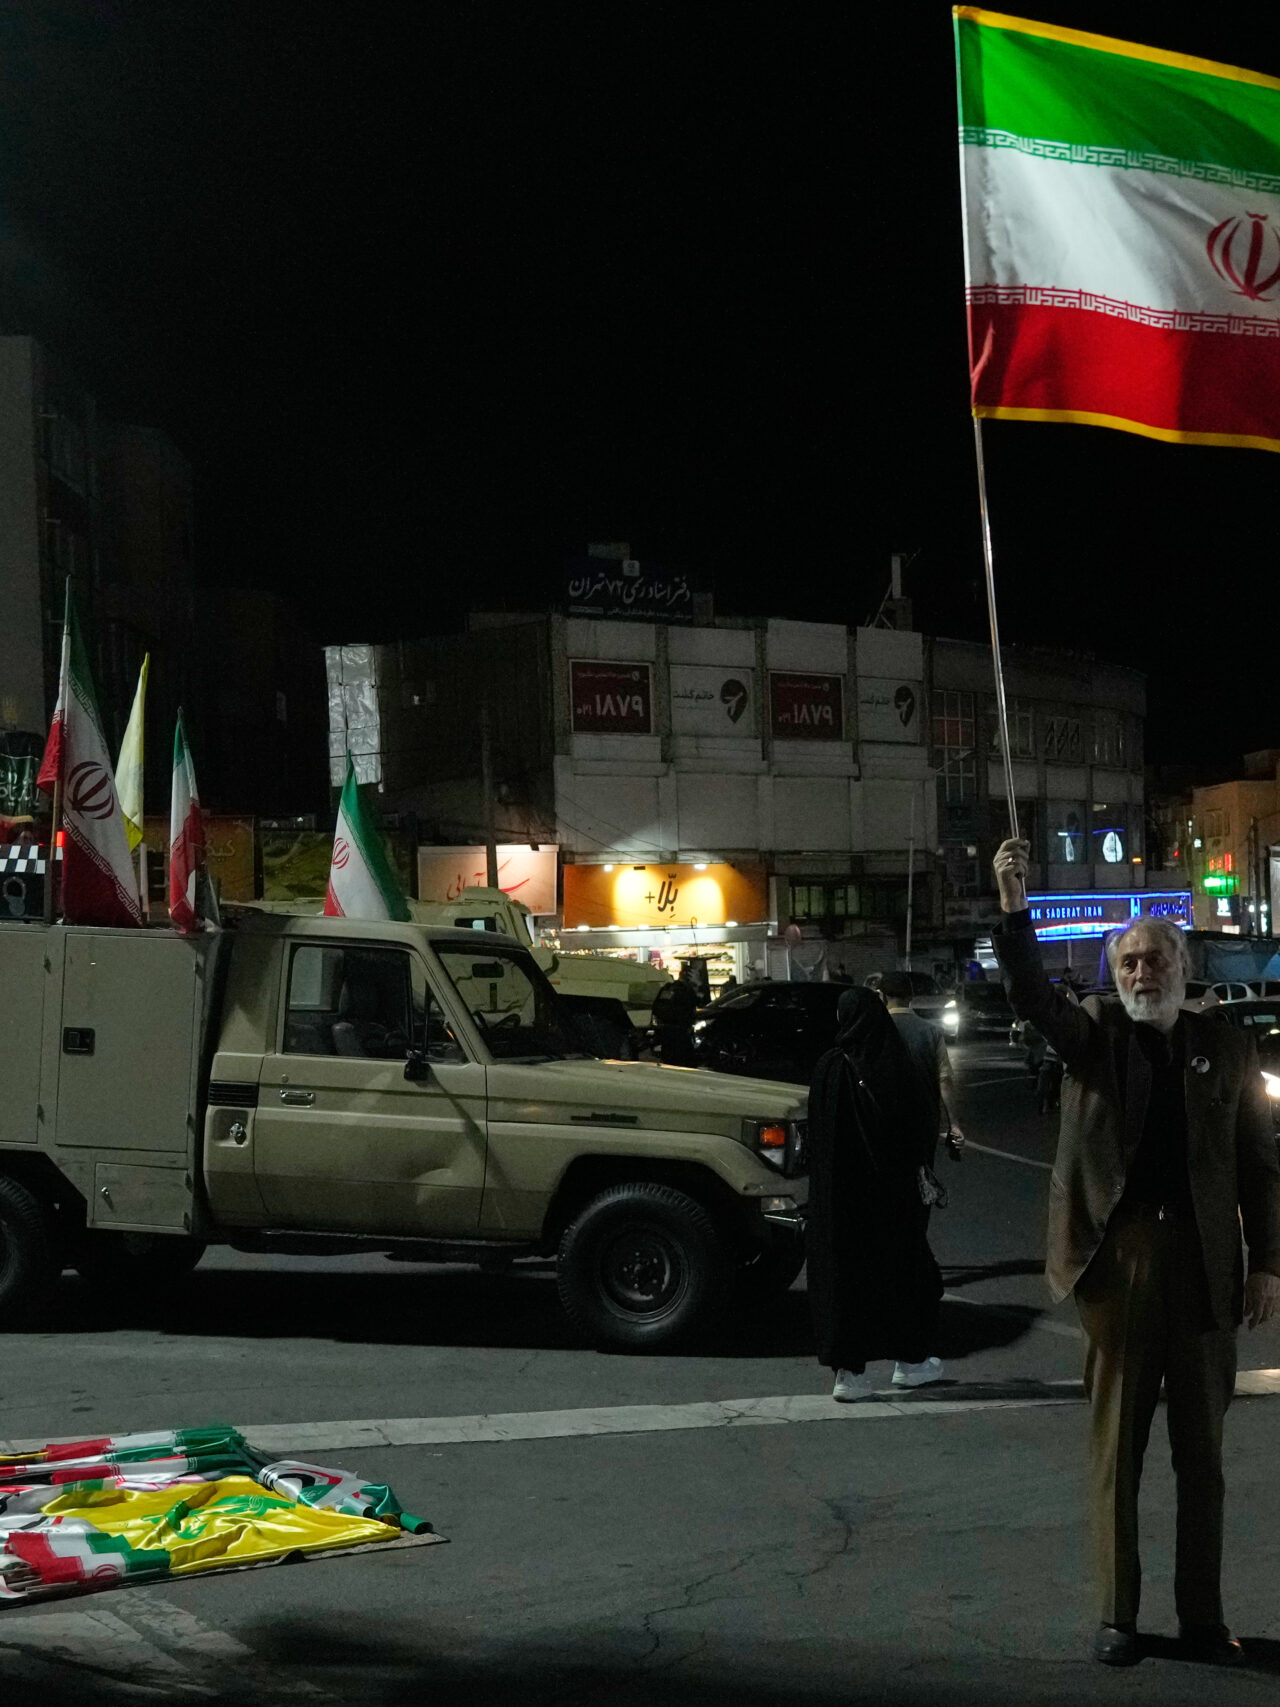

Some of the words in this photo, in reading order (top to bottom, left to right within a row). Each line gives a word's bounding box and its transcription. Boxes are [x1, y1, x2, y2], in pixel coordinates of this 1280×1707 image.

[594, 693, 644, 718] ۱۸۷۹
[793, 703, 834, 726] ۱۸۷۹
[1046, 906, 1081, 919] SADERAT
[1084, 906, 1103, 918] IRAN
